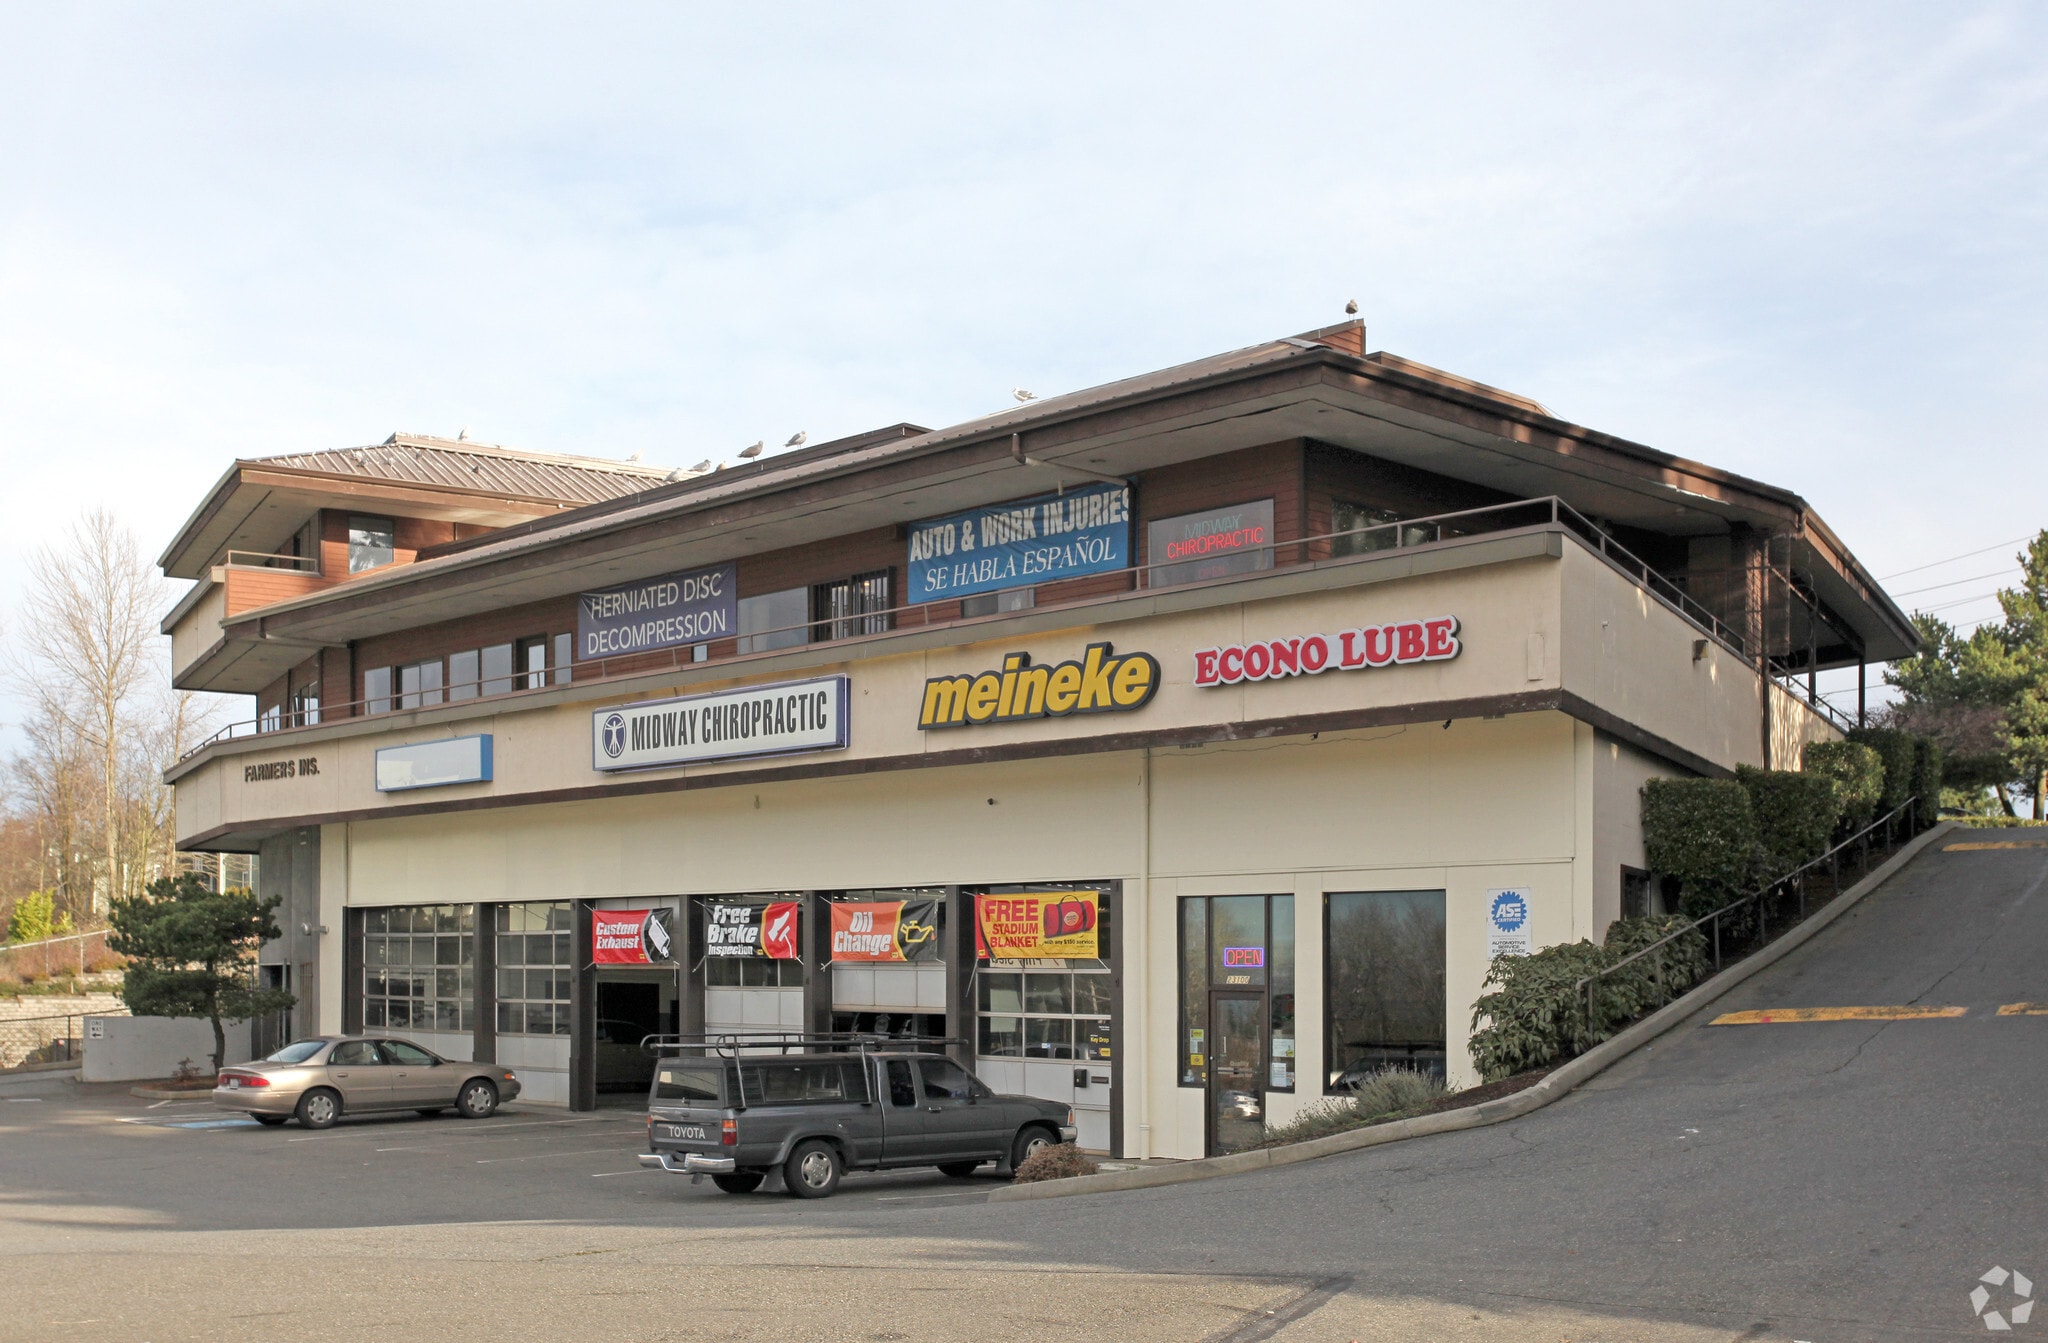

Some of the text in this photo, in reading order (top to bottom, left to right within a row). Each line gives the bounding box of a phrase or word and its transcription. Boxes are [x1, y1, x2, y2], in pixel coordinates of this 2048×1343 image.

[910, 523, 955, 562] AUTO
[961, 519, 975, 552] &
[981, 506, 1037, 548] WORK
[1167, 513, 1264, 559] MIDWAY CHIROPRACTIC
[924, 534, 1117, 592] SE HABLA ESPAÑOL
[591, 572, 722, 620] HERNIATED DISC
[588, 608, 726, 654] DECOMPRESSION
[1194, 618, 1455, 685] ECONO LUBE
[920, 647, 1152, 726] meineke
[631, 690, 828, 752] MIDWAY CHIROPRACTIC
[244, 756, 320, 783] FARMERS INS.
[713, 904, 752, 924] Free
[984, 899, 1039, 922] FREE
[1496, 903, 1521, 917] ASE
[595, 922, 639, 935] Custom
[849, 911, 874, 932] Oil
[992, 922, 1039, 935] STADIUM
[596, 935, 640, 949] Exhaust
[707, 924, 758, 944] Brake
[833, 930, 892, 955] Change
[990, 936, 1039, 948] BLANKET
[708, 944, 753, 957] Inspection
[1227, 949, 1262, 965] OPEN
[669, 1126, 706, 1139] TOYOTA
